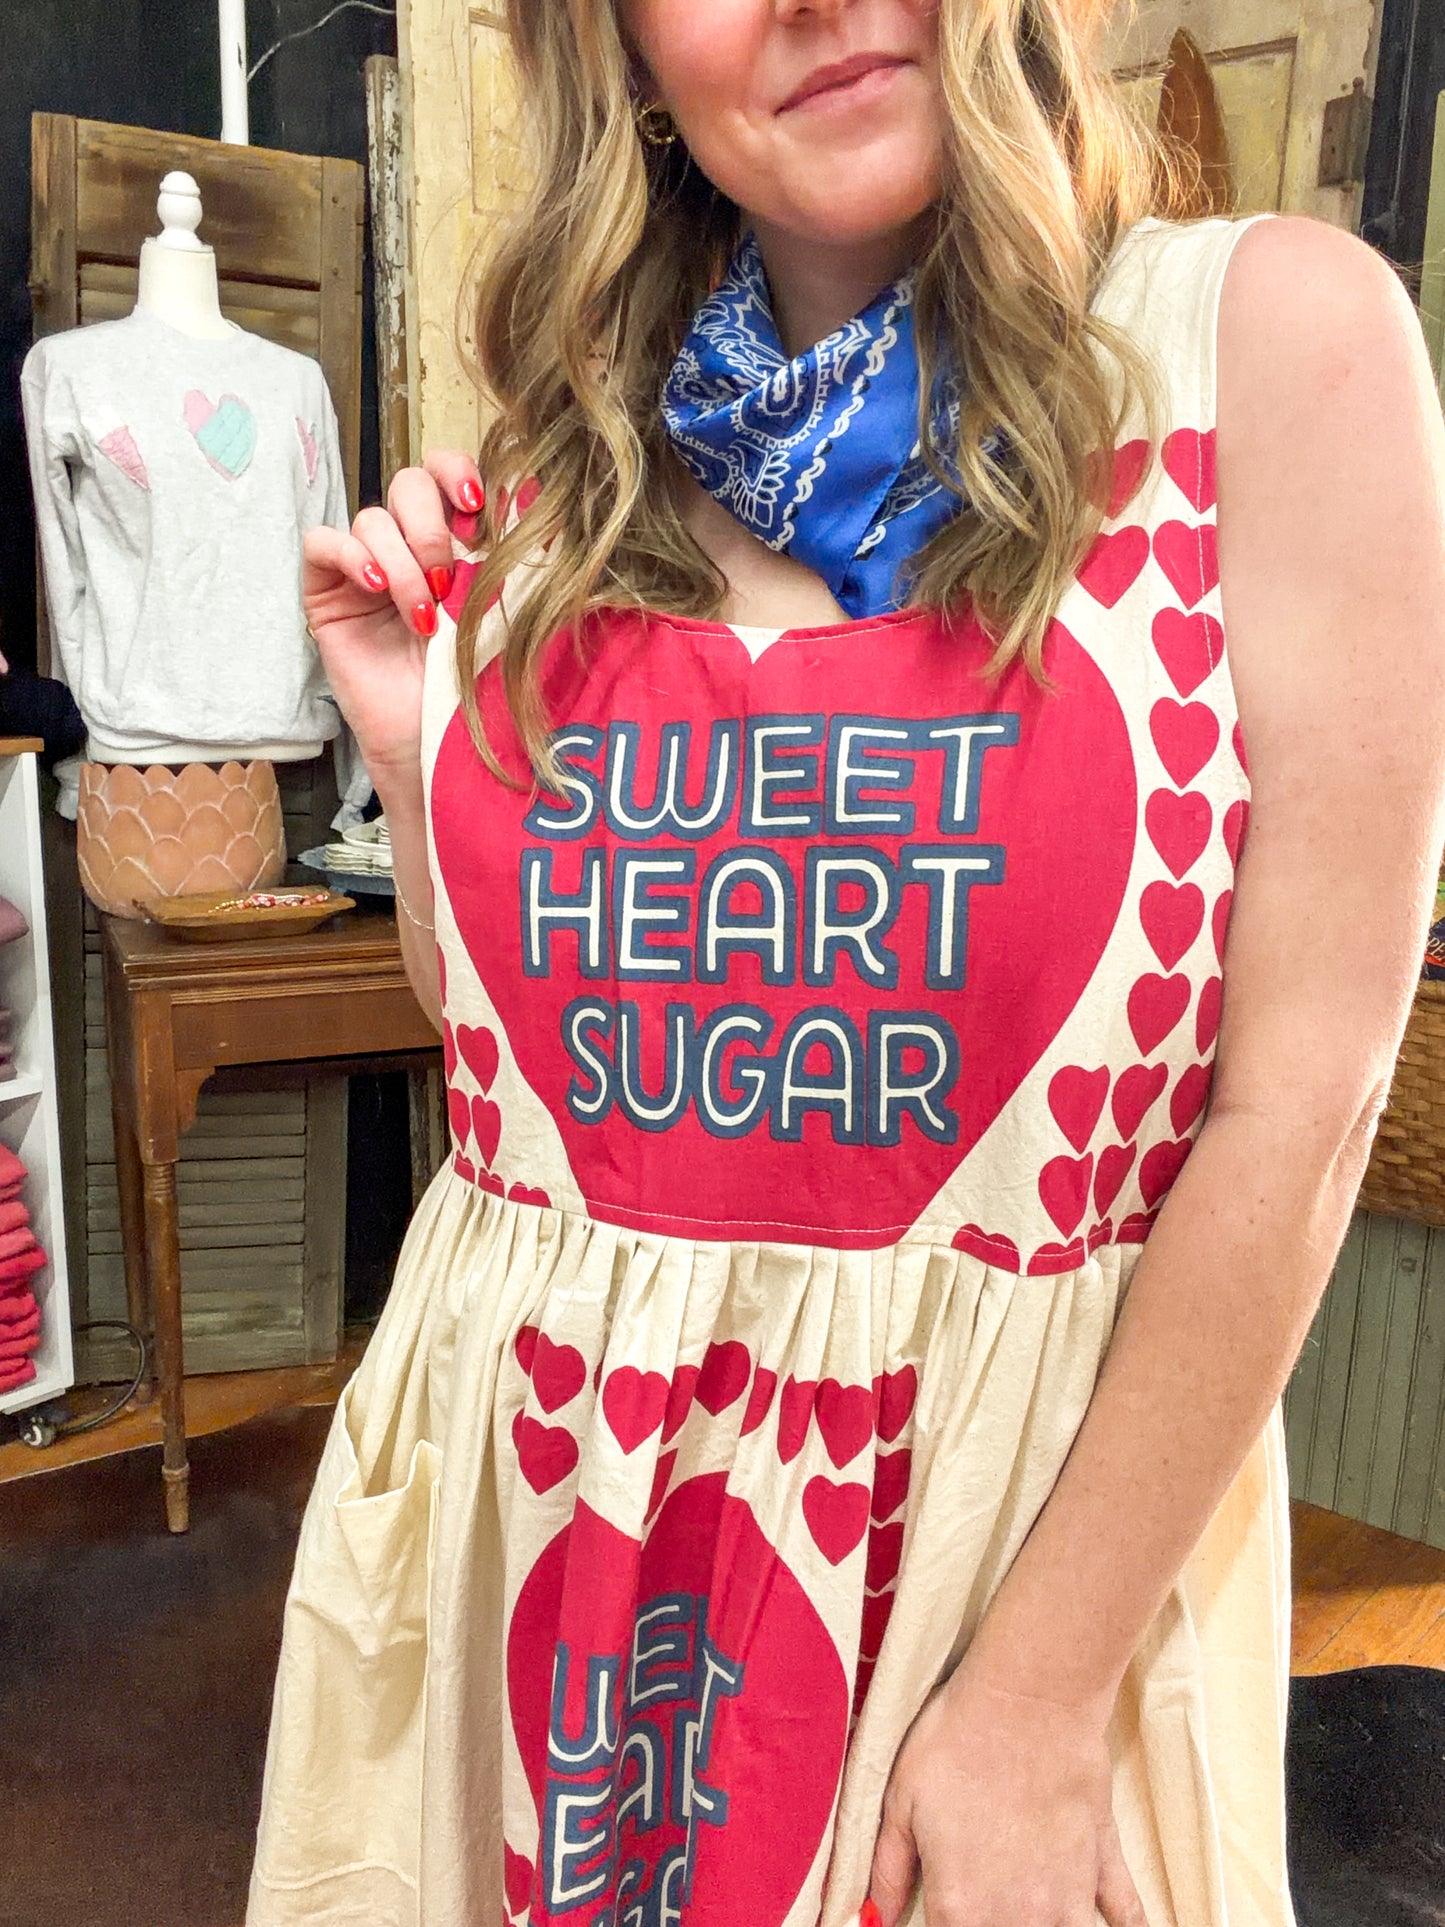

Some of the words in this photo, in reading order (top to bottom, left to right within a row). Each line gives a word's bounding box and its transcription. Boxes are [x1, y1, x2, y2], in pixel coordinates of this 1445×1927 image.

[522, 713, 1020, 842] SWEET
[520, 843, 1006, 991] HEART
[560, 996, 961, 1146] SUGAR
